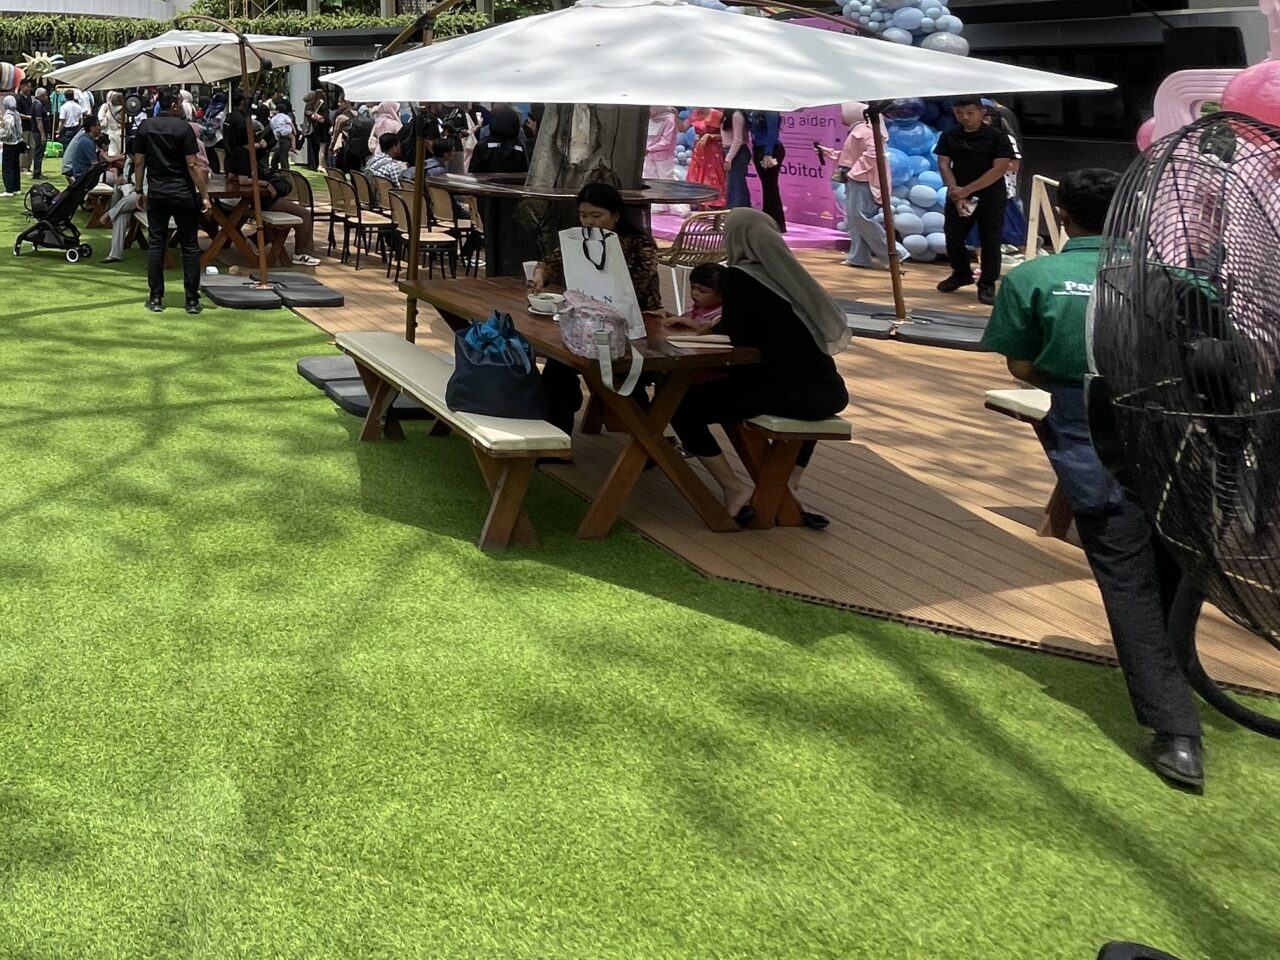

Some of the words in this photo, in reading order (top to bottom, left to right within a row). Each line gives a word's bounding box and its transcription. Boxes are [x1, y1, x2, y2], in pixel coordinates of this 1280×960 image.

[780, 116, 795, 128] ng
[799, 115, 836, 128] aiden
[780, 162, 824, 179] abitat
